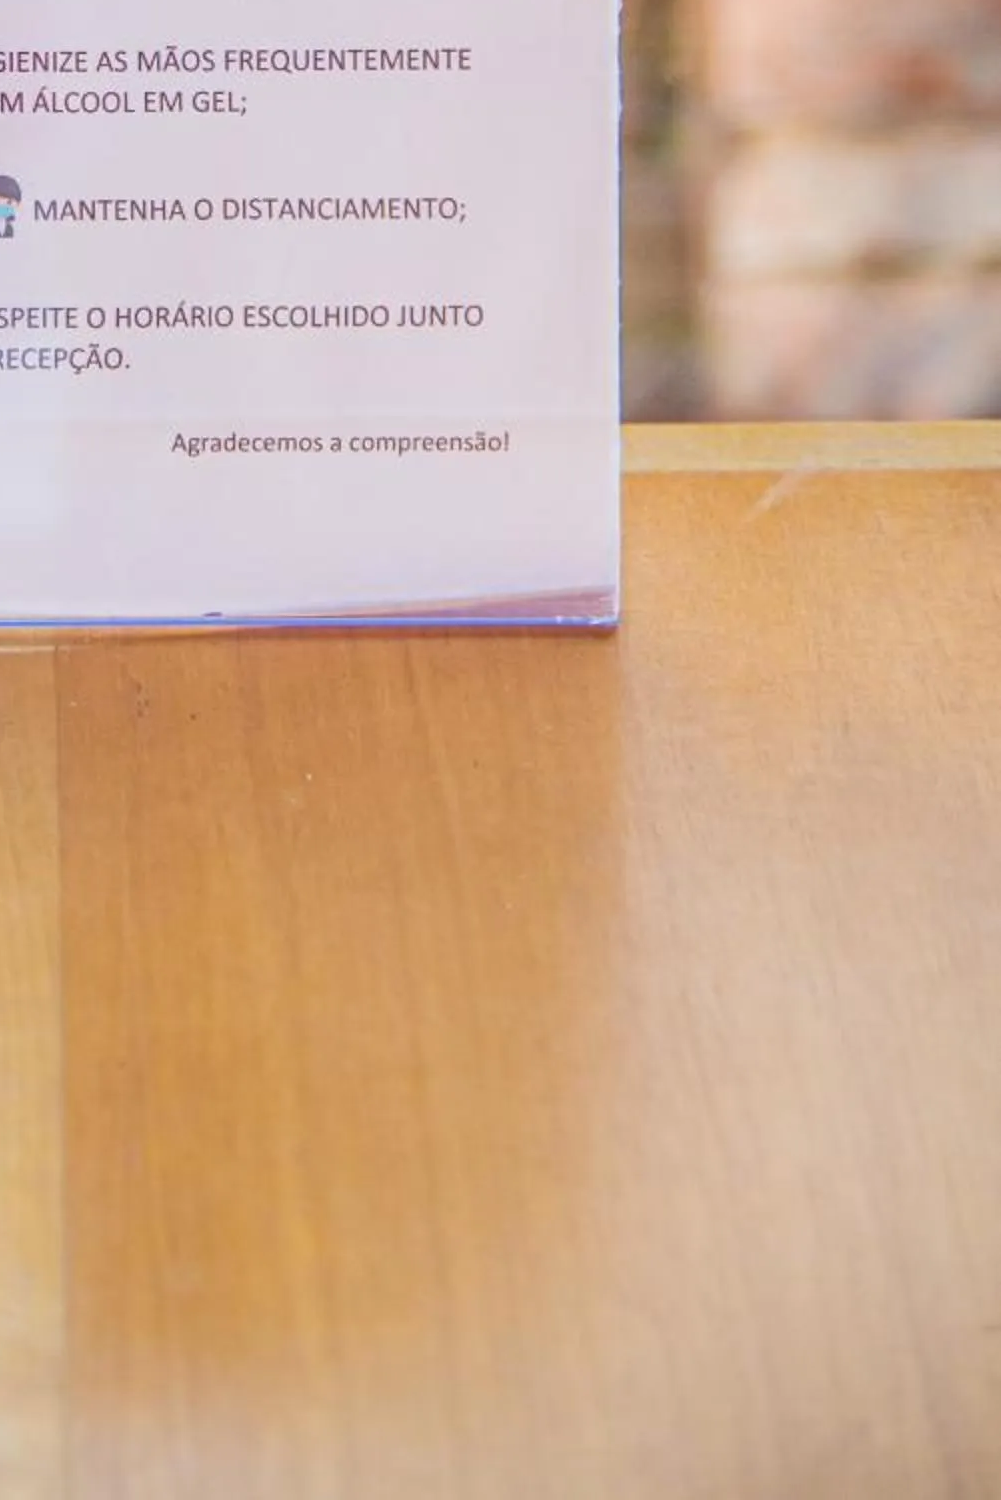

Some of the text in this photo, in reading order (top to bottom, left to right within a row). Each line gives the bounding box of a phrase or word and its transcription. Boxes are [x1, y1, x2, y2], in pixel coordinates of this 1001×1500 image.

[95, 49, 128, 73] AS
[136, 44, 216, 74] MÃOS
[223, 47, 472, 75] FREQUENTEMENTE
[31, 85, 136, 115] ÁLCOOL
[143, 90, 184, 114] EM
[191, 90, 247, 117] GEL;
[33, 196, 466, 224] MANTENHA O DISTANCIAMENTO;
[86, 306, 107, 330] O
[114, 299, 234, 329] HORÁRIO
[243, 304, 390, 329] ESCOLHIDO
[396, 304, 484, 328] JUNTO
[171, 430, 510, 458] Agradecemos a compreensão!
